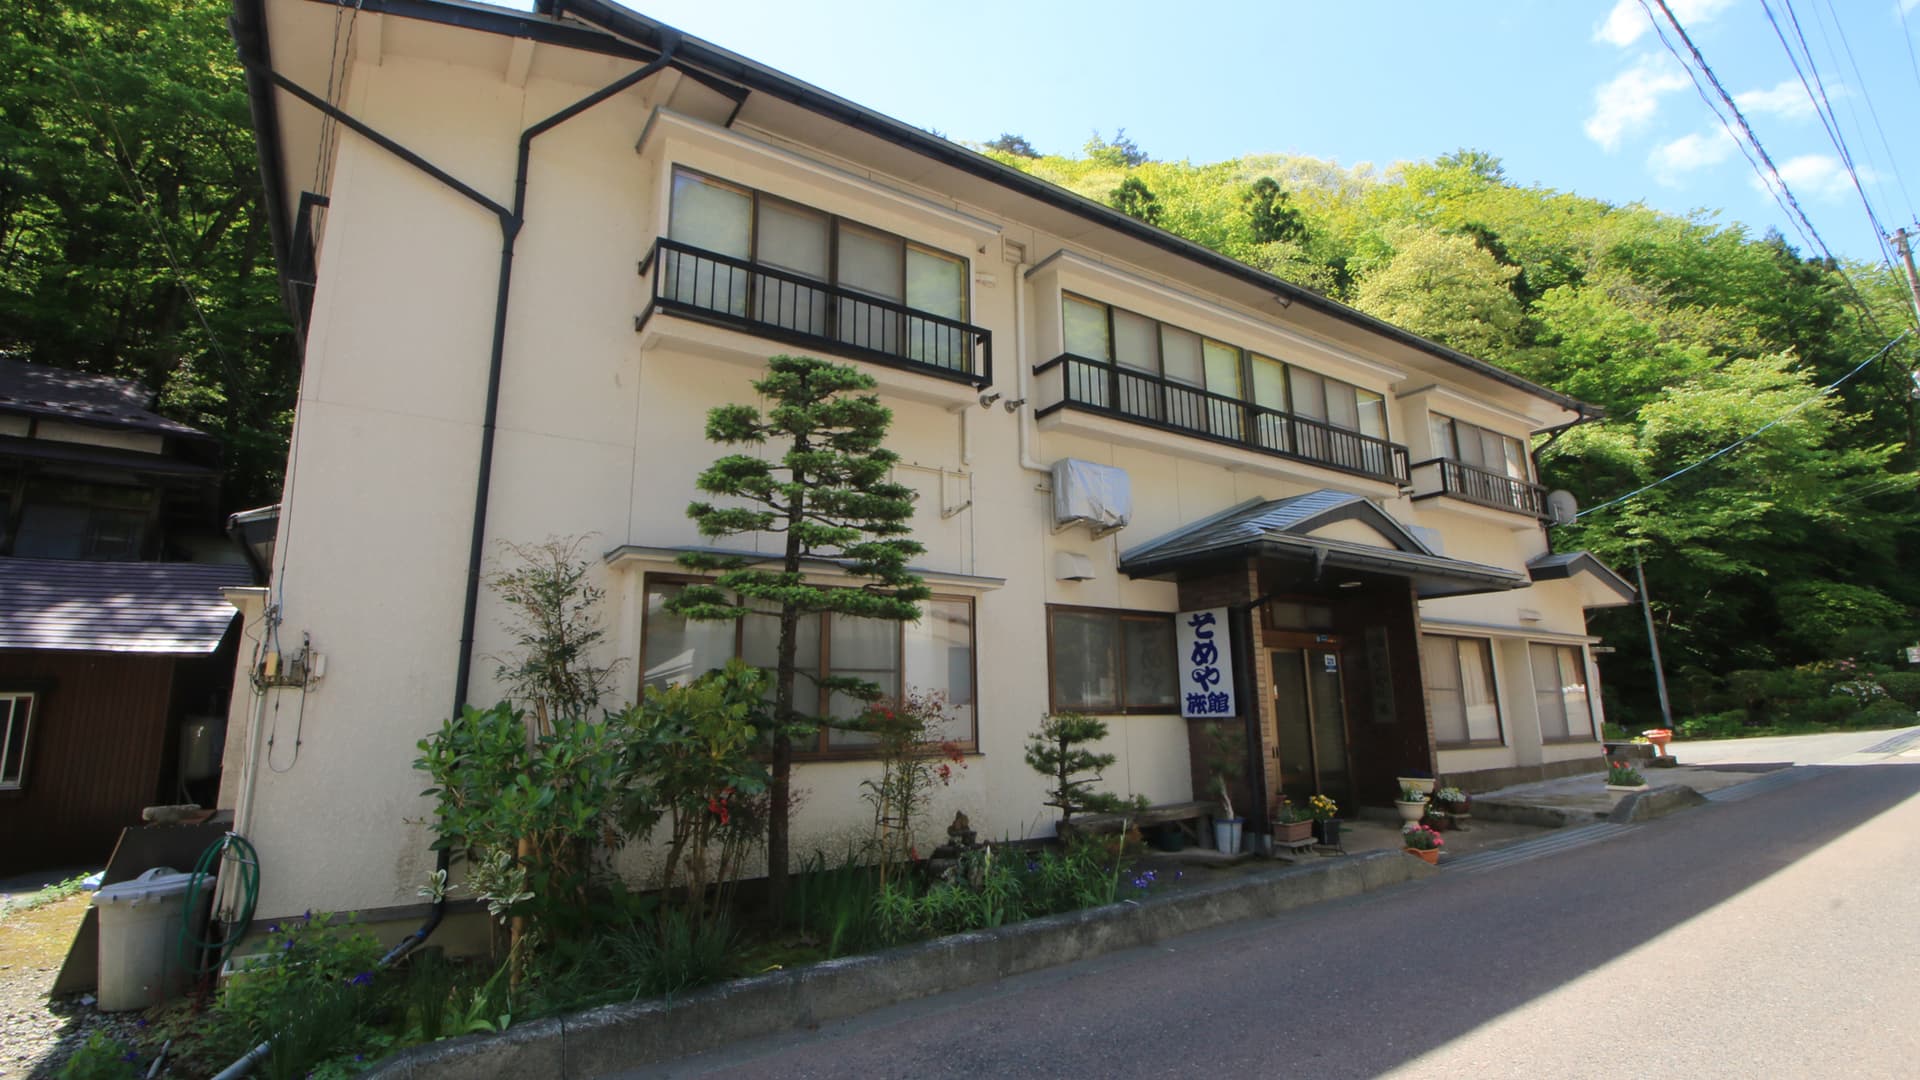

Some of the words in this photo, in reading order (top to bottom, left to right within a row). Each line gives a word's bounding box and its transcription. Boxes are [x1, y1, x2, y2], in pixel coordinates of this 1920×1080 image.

[1187, 612, 1220, 692] そめや
[1186, 692, 1230, 714] 旅館
